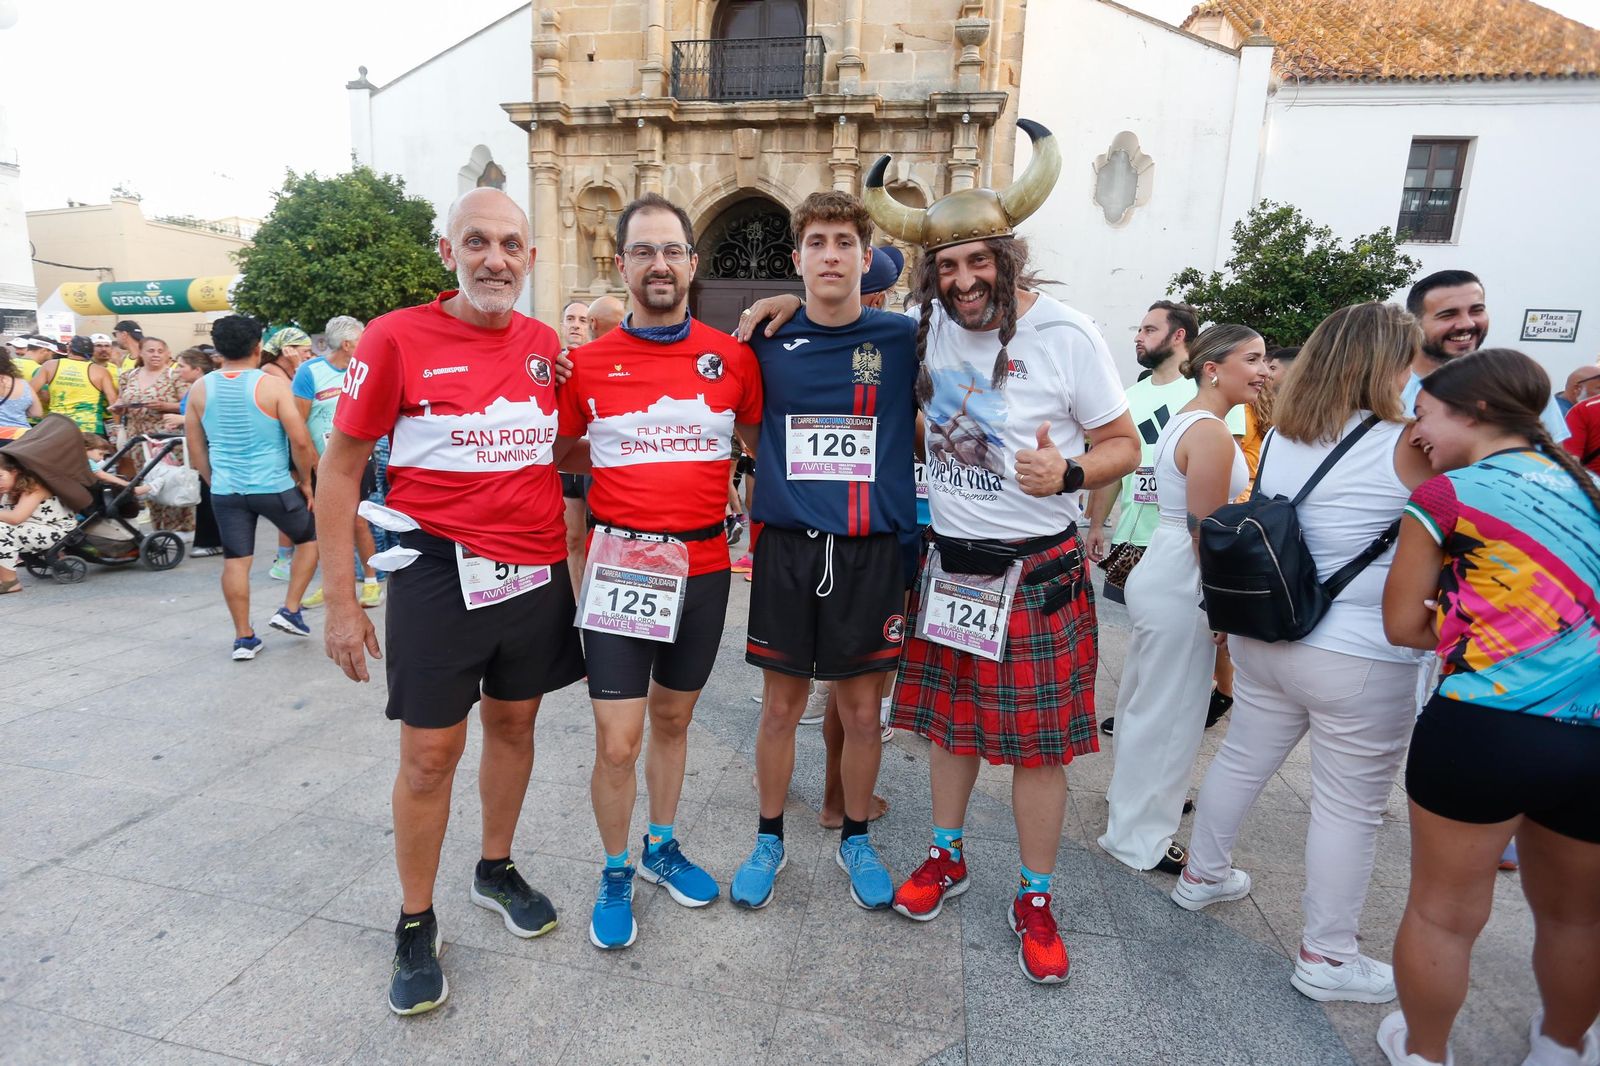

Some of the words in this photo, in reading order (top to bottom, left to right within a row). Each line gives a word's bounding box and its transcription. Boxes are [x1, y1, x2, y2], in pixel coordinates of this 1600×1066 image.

[111, 295, 175, 306] DEPORTES
[1540, 313, 1564, 321] Plaza
[1532, 326, 1568, 334] Iglesia
[451, 430, 494, 447] SAN
[499, 428, 554, 447] ROQUE
[637, 424, 702, 437] RUNNING
[621, 439, 658, 456] SAN
[661, 438, 719, 453] ROQUE
[807, 433, 857, 457] 126
[477, 449, 538, 463] RUNNING
[800, 462, 836, 472] AVATEL
[949, 458, 963, 488] la
[966, 466, 1004, 491] vida
[482, 582, 517, 600] AVATEL
[607, 587, 658, 617] 125
[597, 616, 633, 630] AVATEL
[611, 612, 628, 620] GRAN
[946, 600, 987, 632] 124
[937, 627, 968, 642] AVATEL
